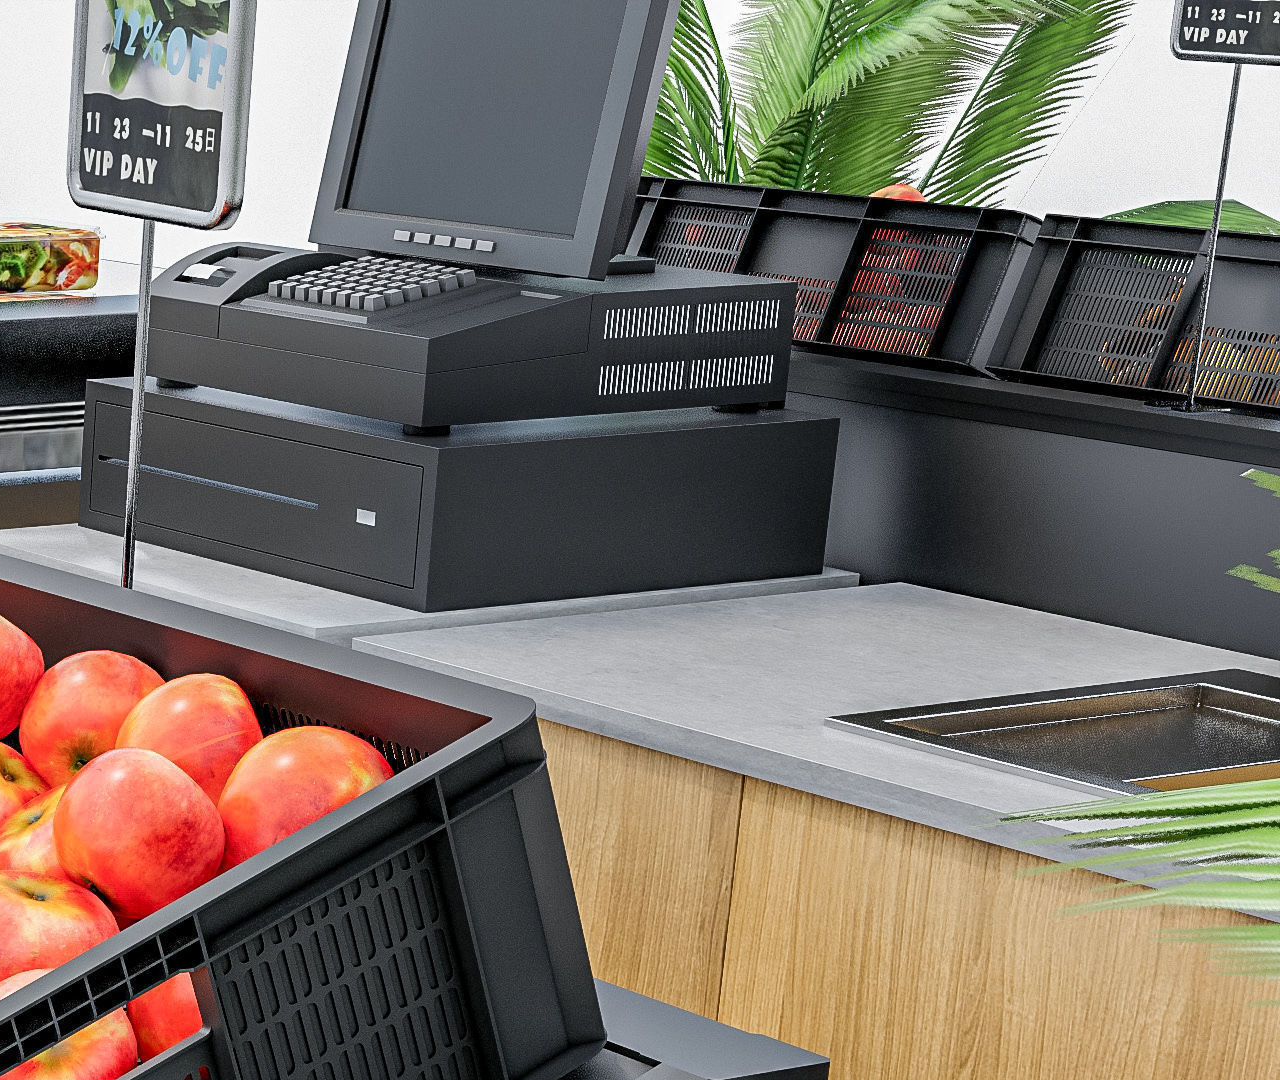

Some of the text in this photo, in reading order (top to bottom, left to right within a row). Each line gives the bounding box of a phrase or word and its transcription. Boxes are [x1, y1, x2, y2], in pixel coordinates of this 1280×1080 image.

[1187, 6, 1199, 18] 11
[1210, 8, 1226, 21] 23
[113, 6, 228, 90] 12%OFF
[1183, 26, 1249, 44] VIP DAY
[86, 111, 100, 134] 11
[113, 117, 130, 139] 23
[83, 147, 158, 185] VIP DAY
